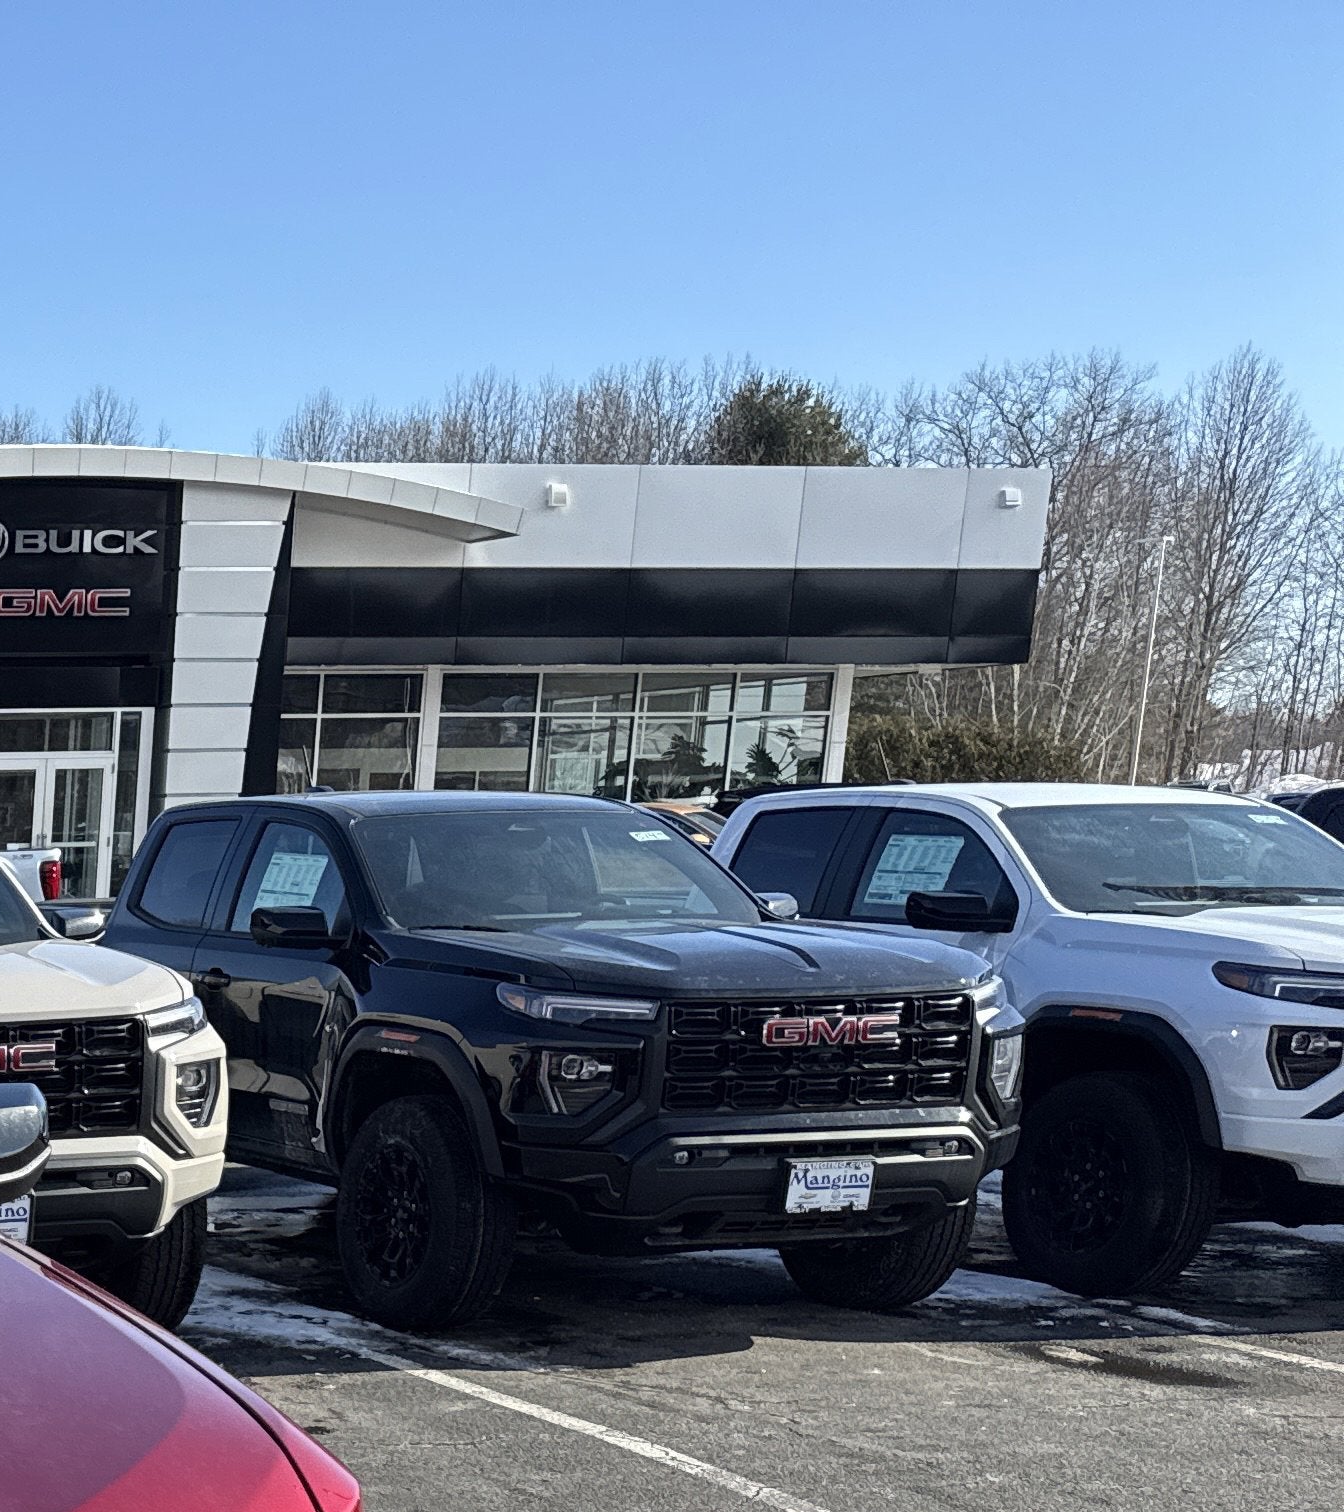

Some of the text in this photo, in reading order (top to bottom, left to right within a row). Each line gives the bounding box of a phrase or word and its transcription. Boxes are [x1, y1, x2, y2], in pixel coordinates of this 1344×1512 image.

[14, 529, 159, 554] BUICK
[763, 1014, 900, 1047] GMC
[790, 1168, 870, 1190] Mangino
